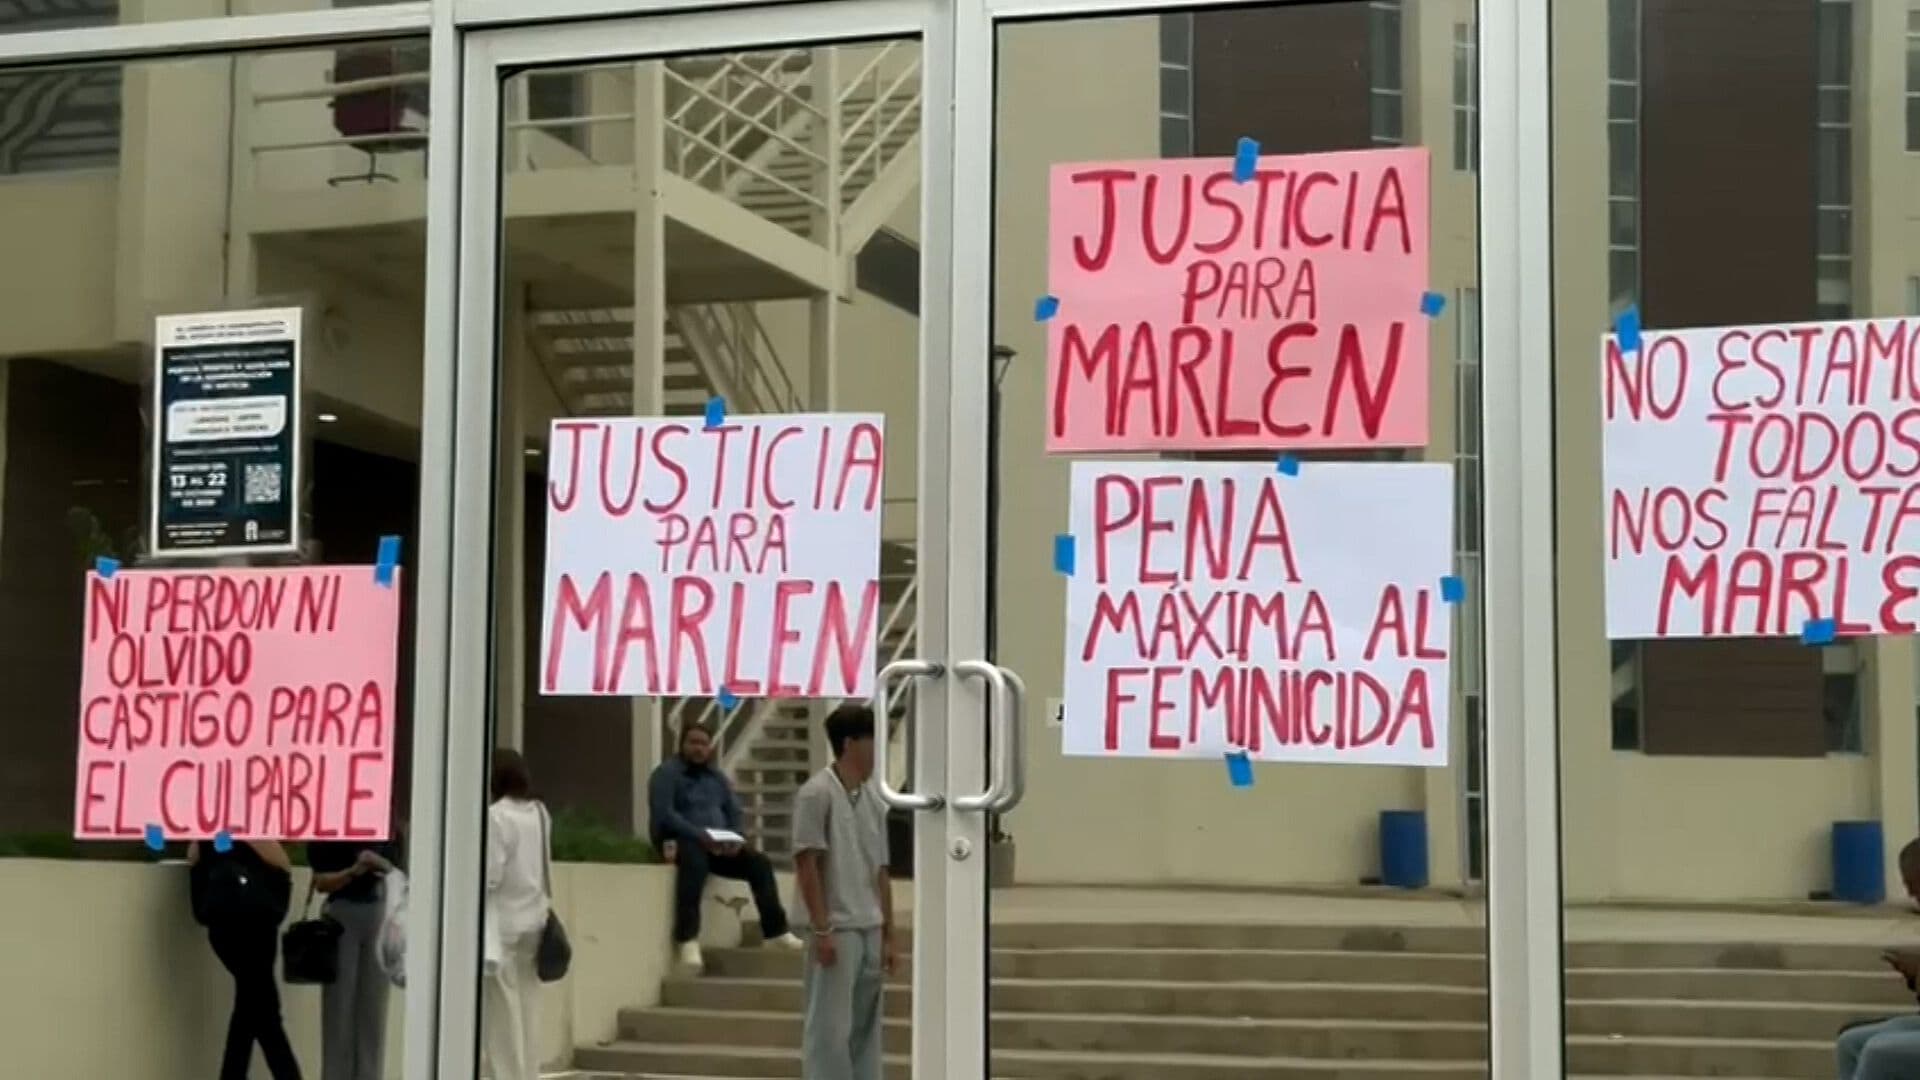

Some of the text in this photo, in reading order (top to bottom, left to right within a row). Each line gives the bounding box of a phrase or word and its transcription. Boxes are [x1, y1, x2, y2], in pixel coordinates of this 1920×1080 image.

[1072, 166, 1412, 272] JUSTICIA
[1182, 257, 1316, 323] PARA
[1054, 321, 1404, 439] MARLEN
[1607, 336, 1688, 421] NO
[550, 423, 883, 517] JUSTICIA
[1706, 408, 1920, 481] TODOS
[654, 512, 787, 574] PARA
[1095, 474, 1302, 583] PENA
[1612, 486, 1728, 559] NOS
[90, 575, 341, 642] NI PERDON NI
[544, 571, 880, 697] MARLEN
[1363, 584, 1447, 660] AL
[108, 631, 253, 688] OLVIDO
[84, 680, 383, 750] CASTIGO PARA
[1105, 666, 1434, 751] FEMINICIDA
[82, 751, 383, 837] EL CULPABLE
